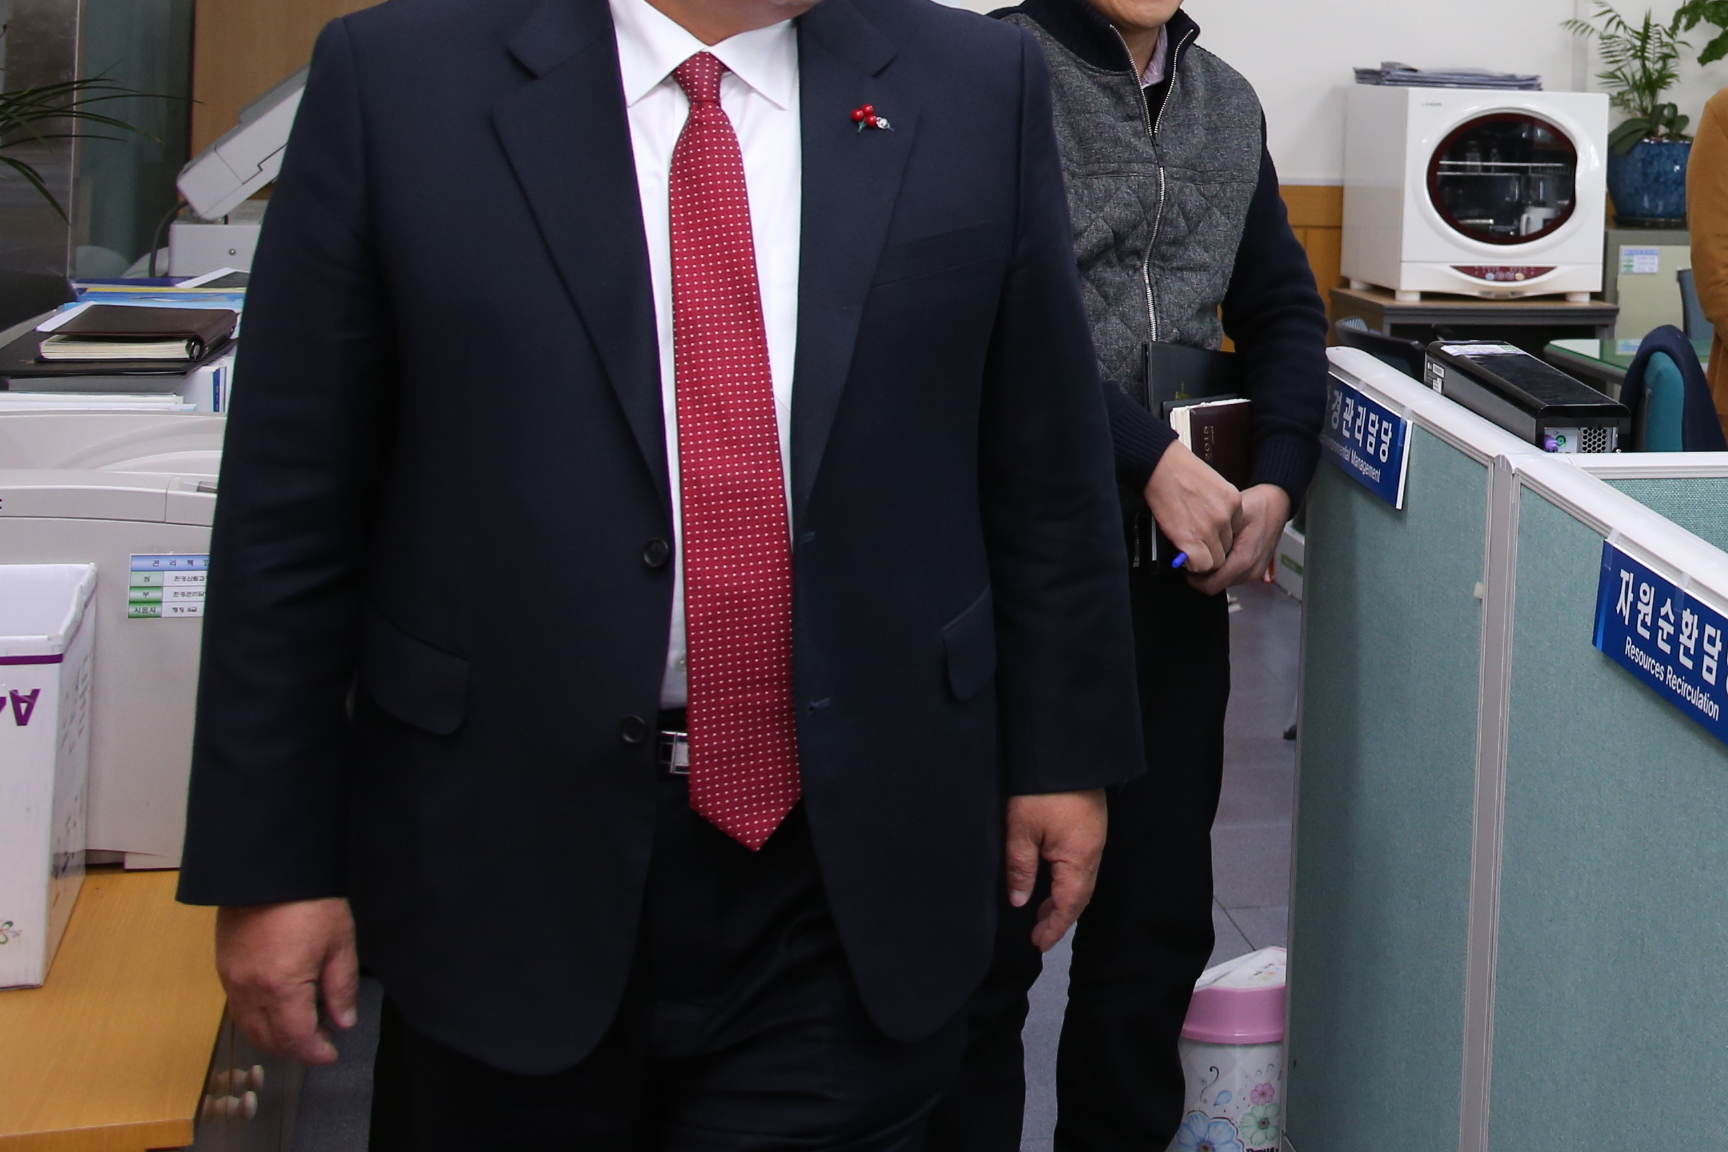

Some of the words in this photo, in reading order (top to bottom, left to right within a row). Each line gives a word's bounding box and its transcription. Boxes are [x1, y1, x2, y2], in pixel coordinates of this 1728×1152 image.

[1327, 385, 1392, 463] 경관리담당
[1351, 449, 1381, 483] Management
[1625, 636, 1665, 681] Resources
[1665, 665, 1720, 721] Recirculation
